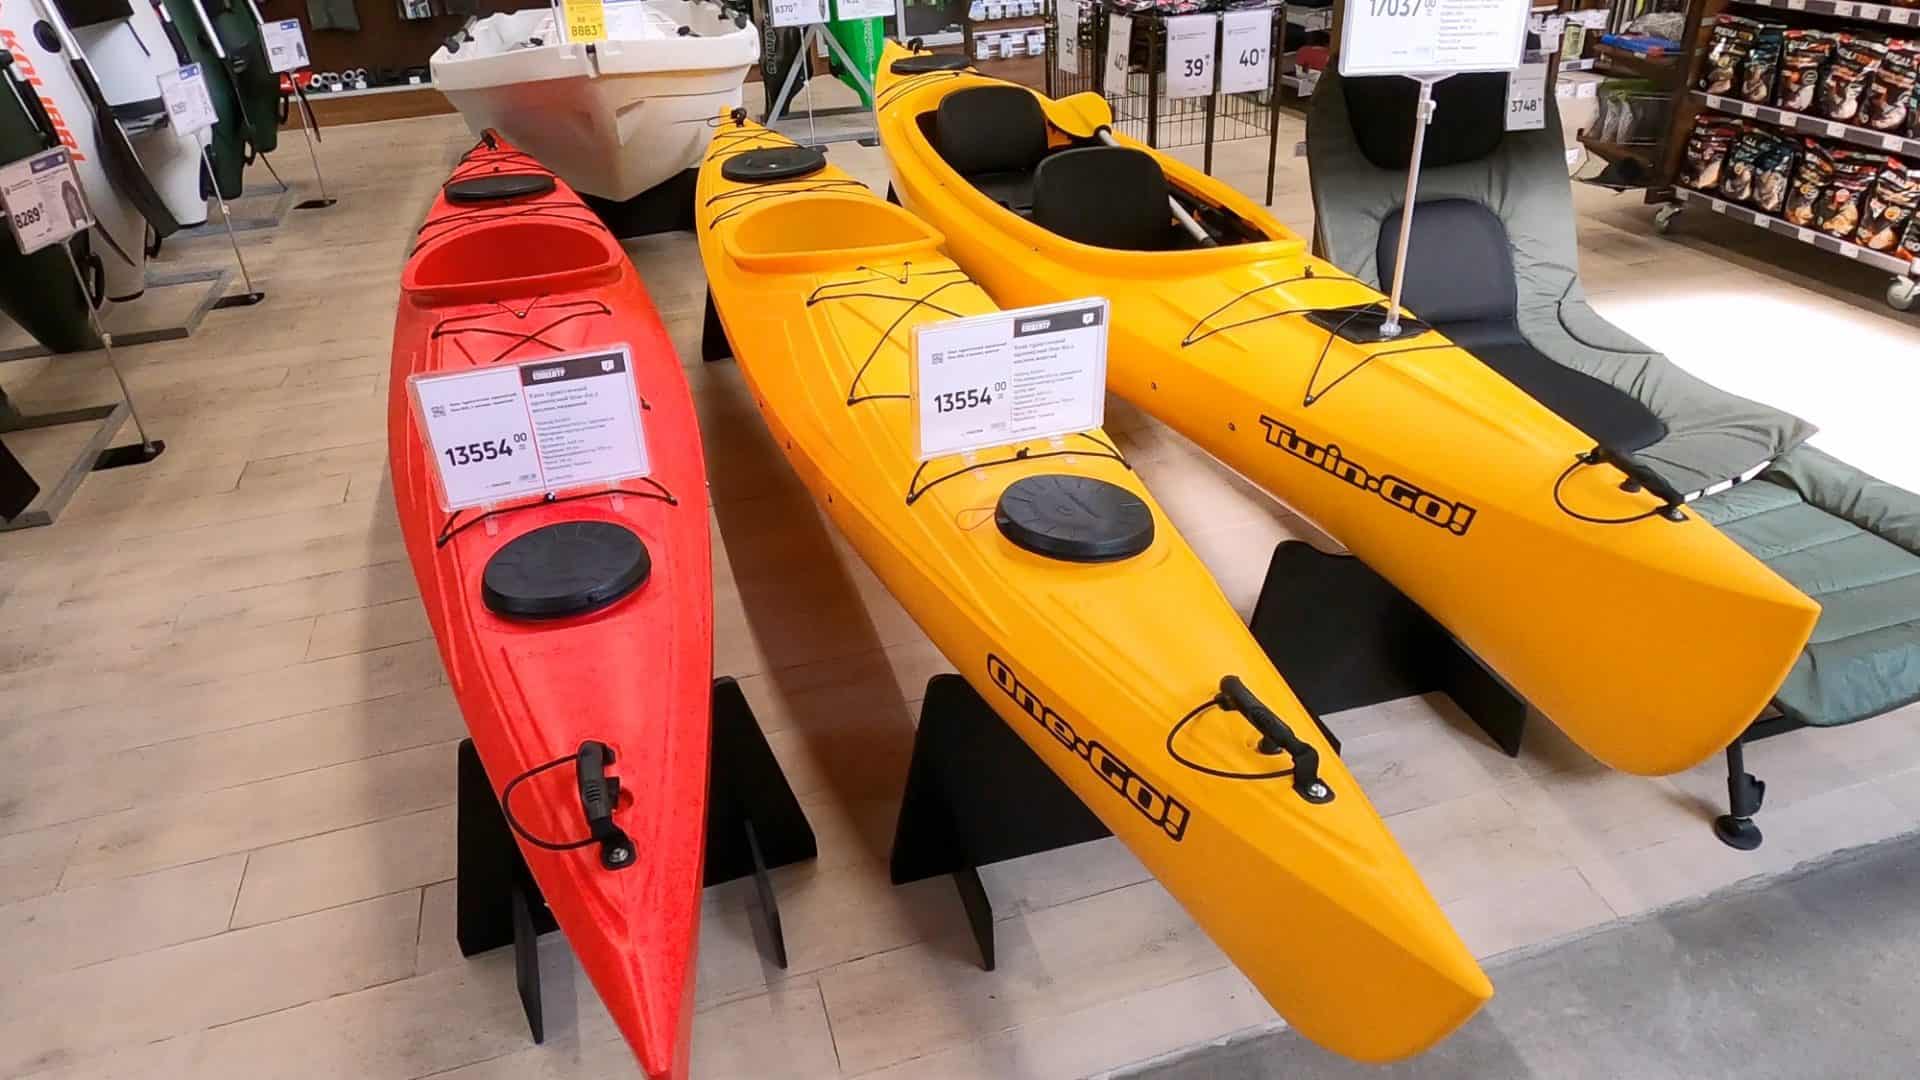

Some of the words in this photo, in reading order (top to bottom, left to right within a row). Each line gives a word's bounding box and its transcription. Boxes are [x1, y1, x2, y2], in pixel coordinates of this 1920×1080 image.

[1184, 58, 1204, 77] 39
[1239, 48, 1260, 67] 40
[1511, 99, 1537, 113] 3748
[14, 208, 41, 229] 8289
[933, 386, 992, 414] 13554
[994, 380, 1007, 392] 00
[444, 438, 513, 467] 13554
[513, 432, 528, 444] 00
